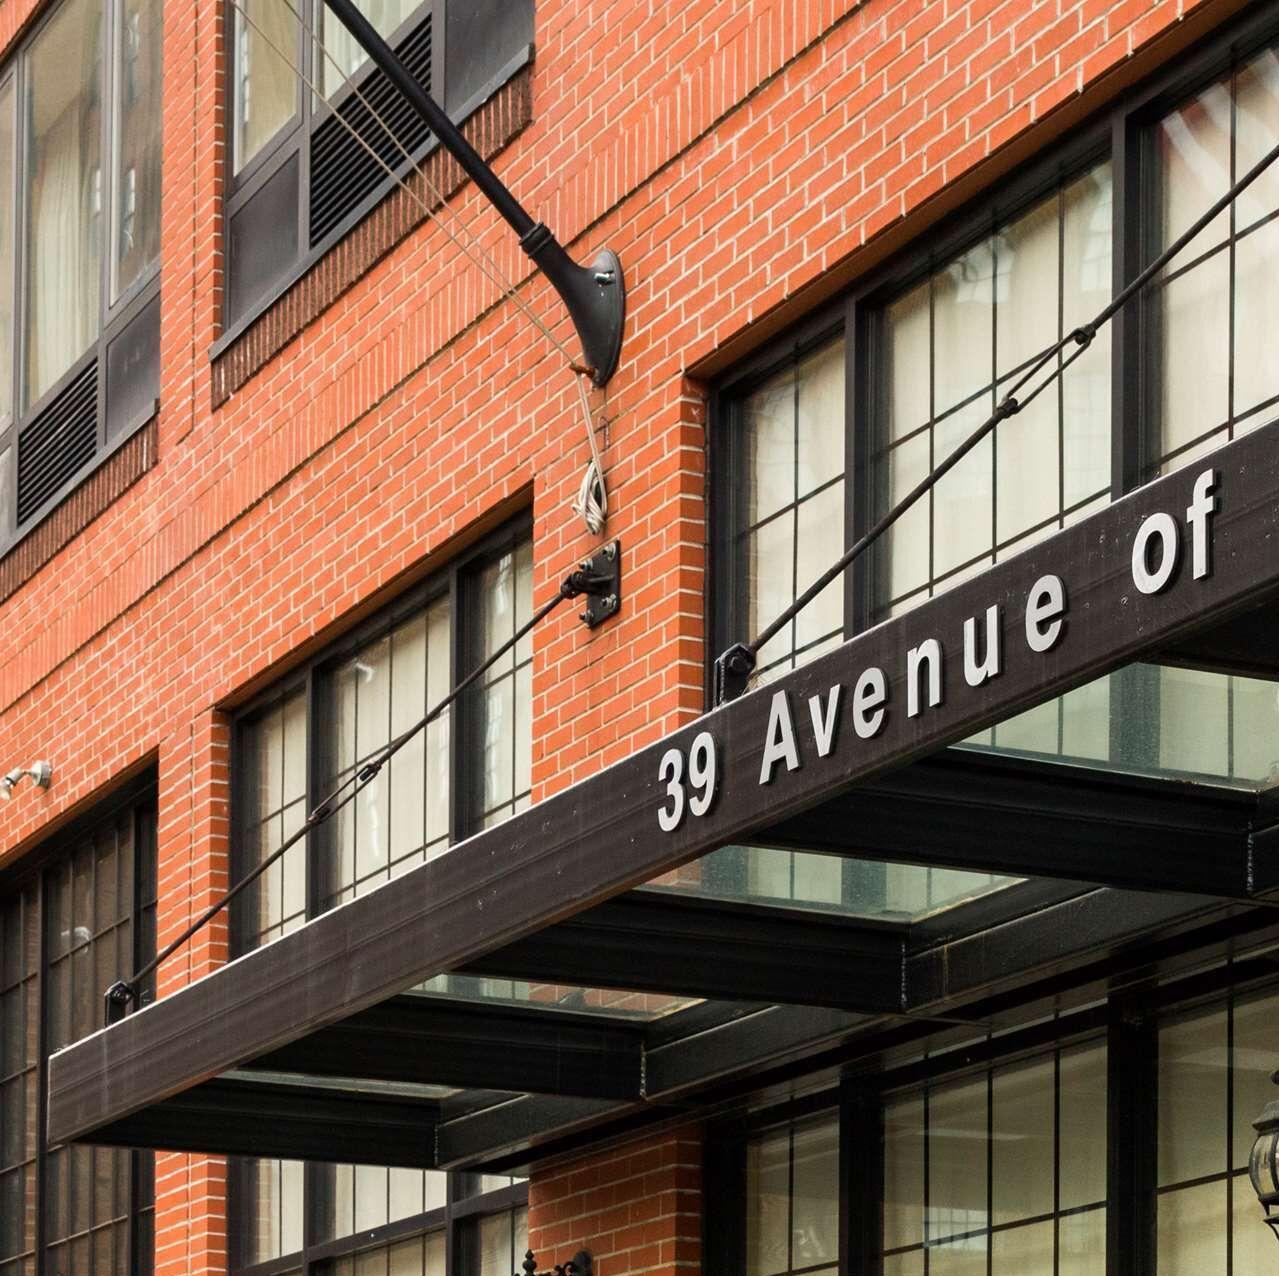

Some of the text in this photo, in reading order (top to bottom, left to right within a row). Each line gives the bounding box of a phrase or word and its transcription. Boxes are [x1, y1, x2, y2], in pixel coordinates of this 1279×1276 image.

[657, 731, 718, 833] 39
[758, 574, 1065, 786] Avenue
[1131, 469, 1216, 596] of
